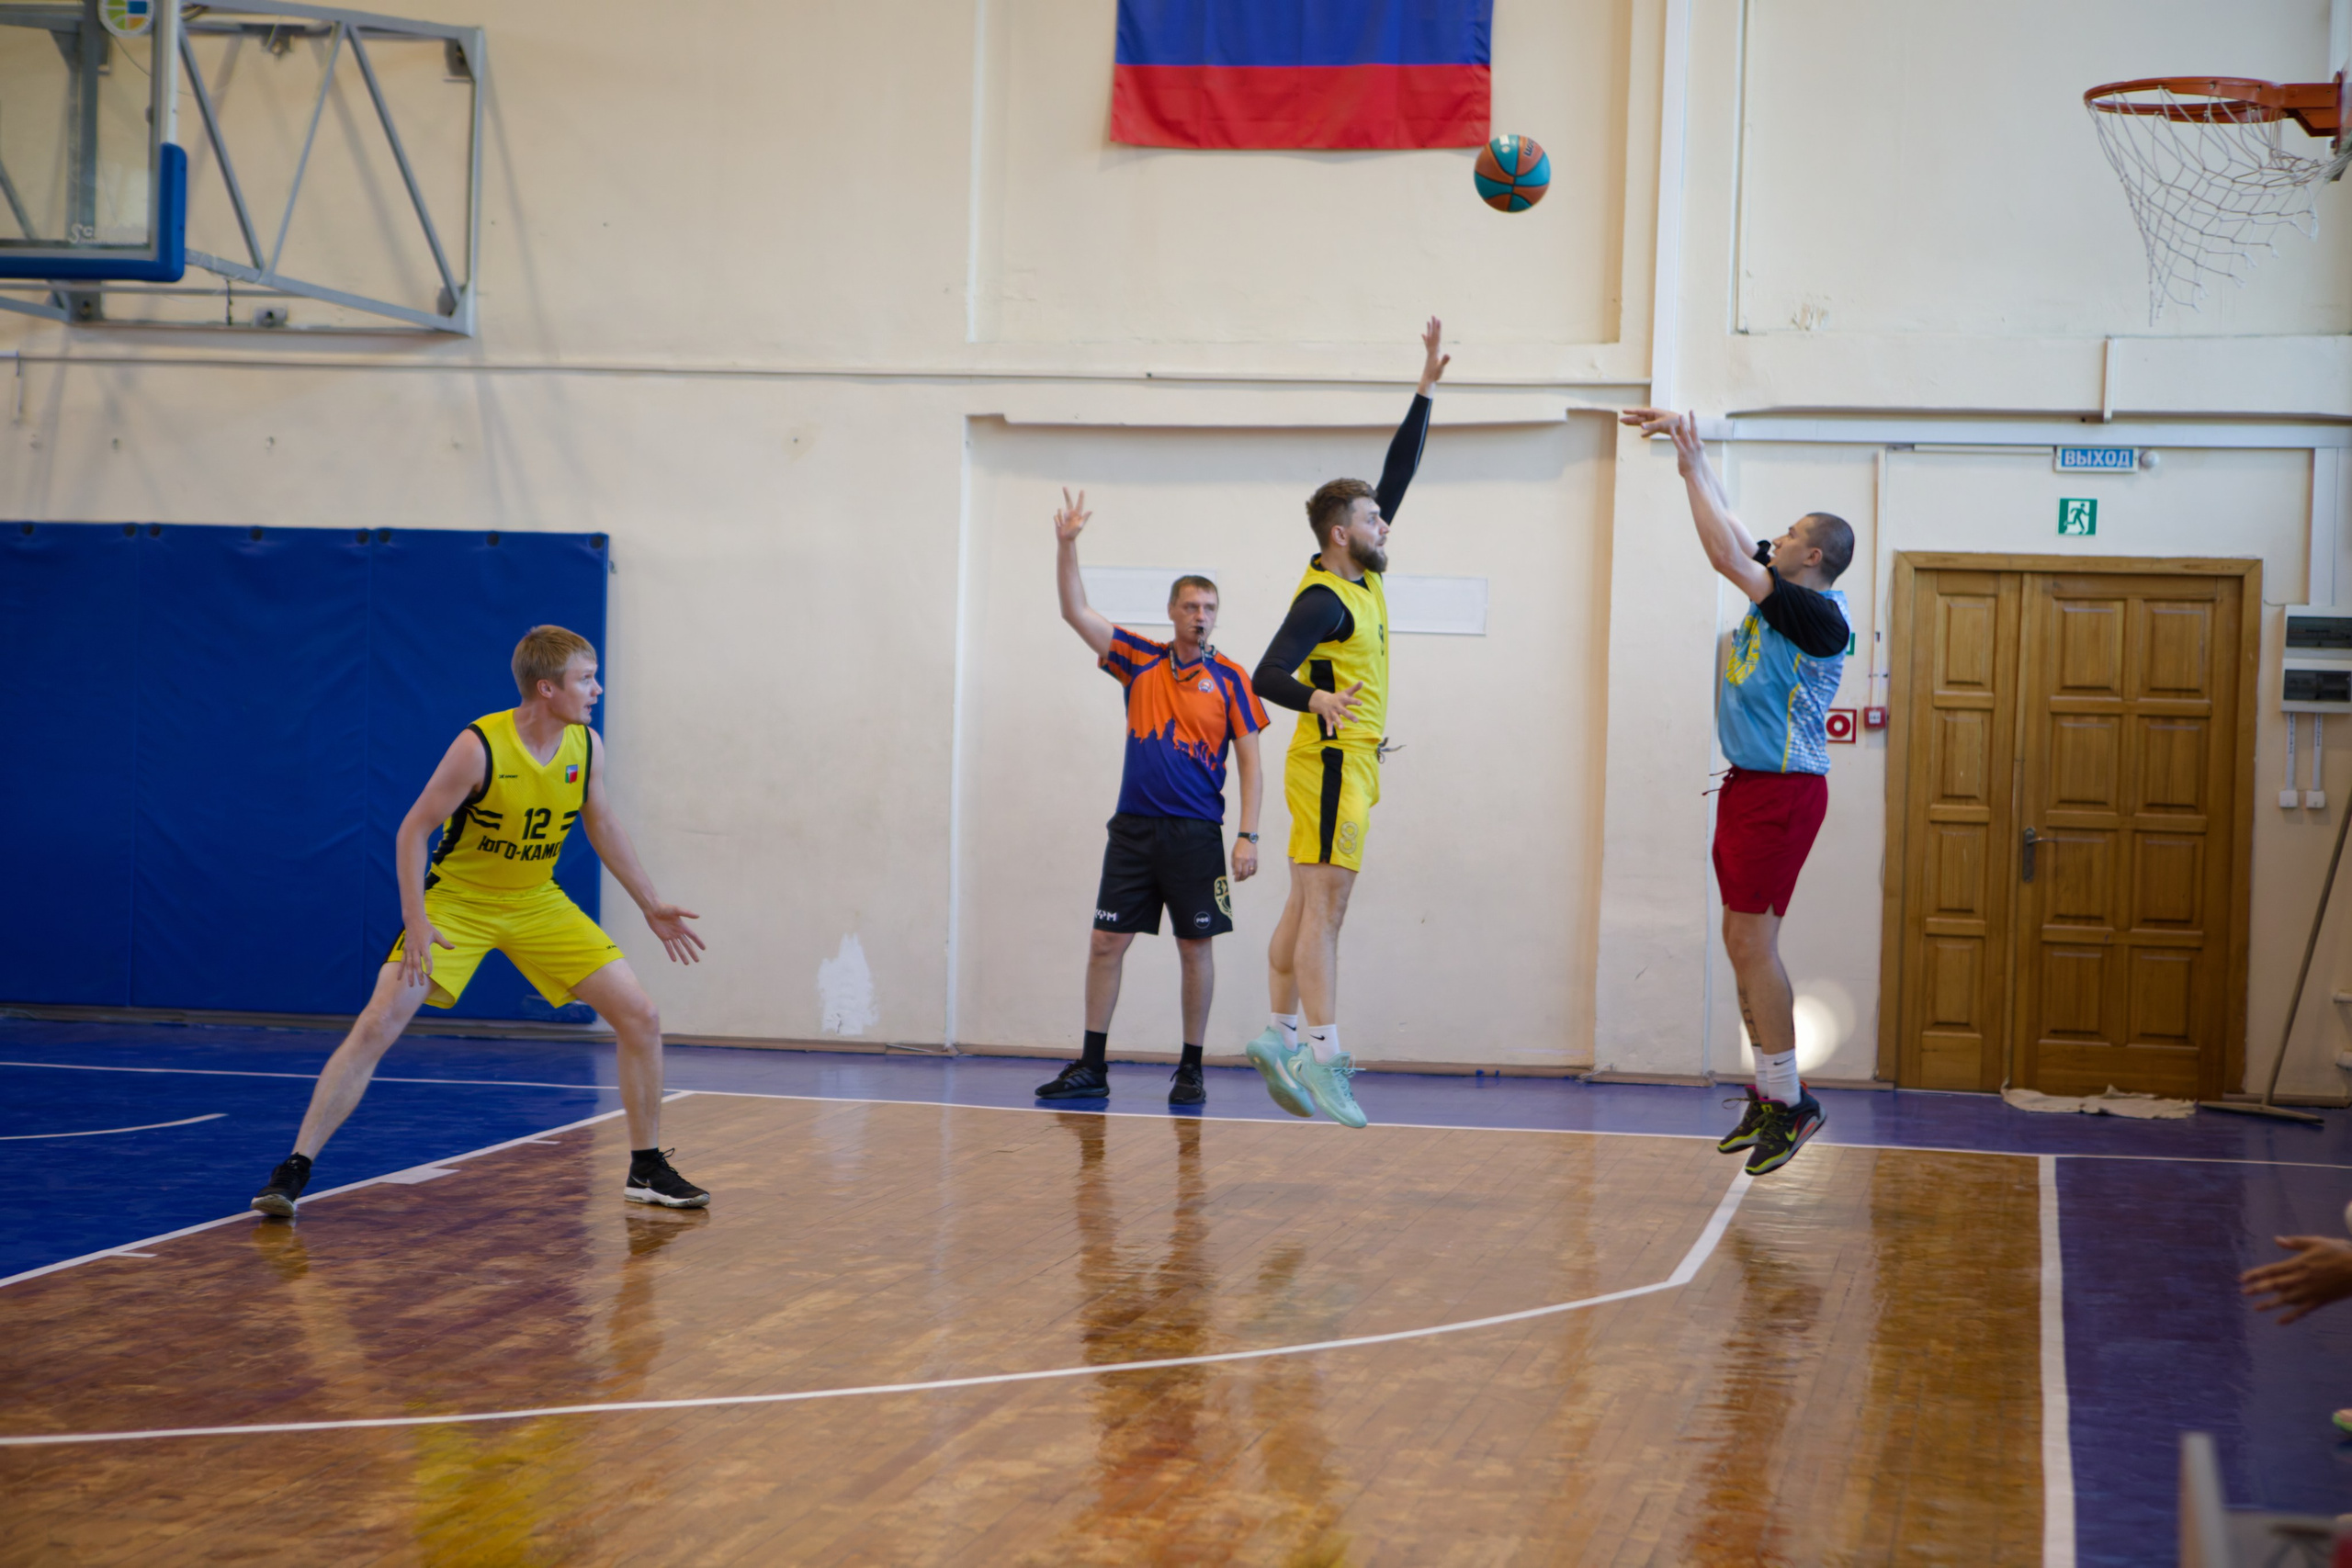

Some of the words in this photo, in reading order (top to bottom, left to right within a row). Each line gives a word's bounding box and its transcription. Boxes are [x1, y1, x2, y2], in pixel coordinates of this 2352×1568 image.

[2064, 450, 2131, 468] ВЫХОД
[522, 808, 551, 840] 12
[1337, 821, 1358, 854] 8
